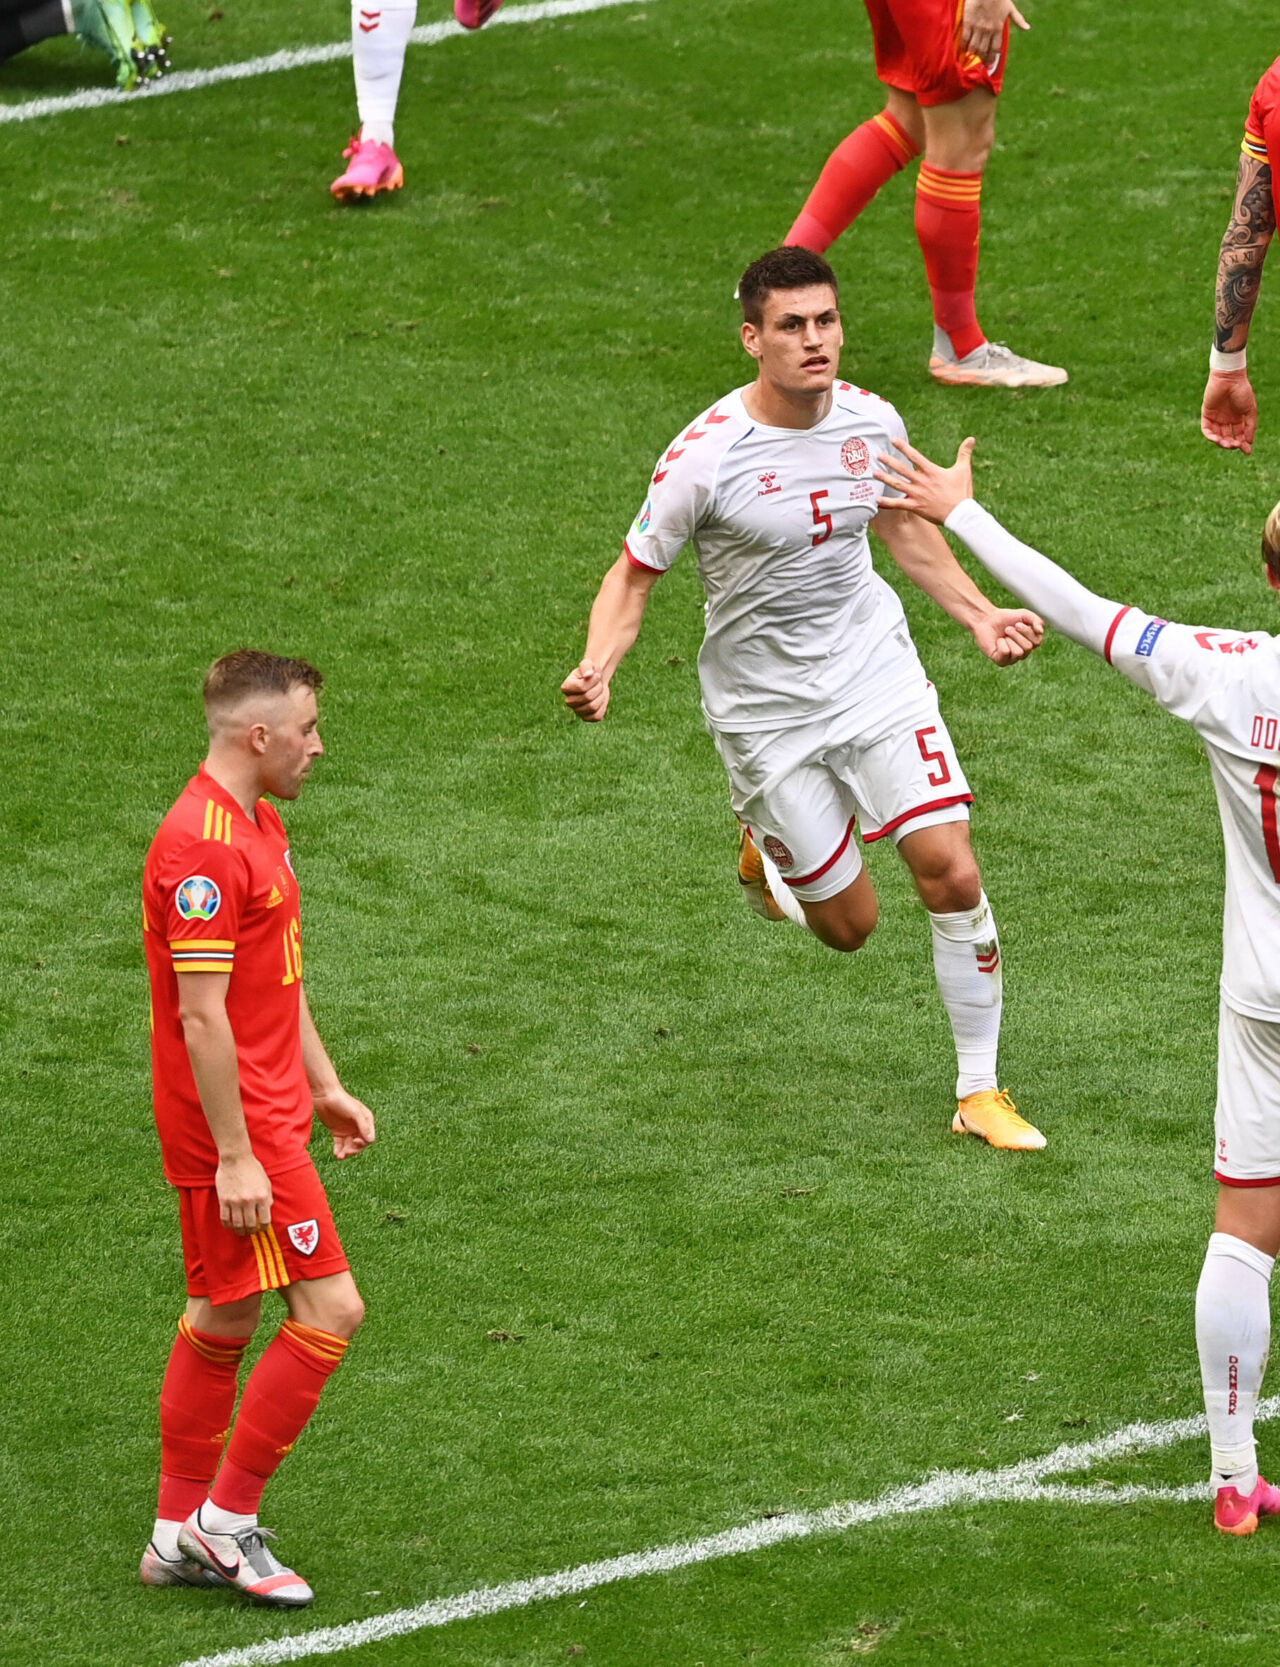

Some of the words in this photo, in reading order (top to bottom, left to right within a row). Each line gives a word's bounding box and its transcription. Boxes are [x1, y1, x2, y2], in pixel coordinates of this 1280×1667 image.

[809, 489, 833, 547] 5
[914, 726, 952, 787] 5
[281, 917, 303, 986] 16
[1228, 1355, 1239, 1416] DANMARK
